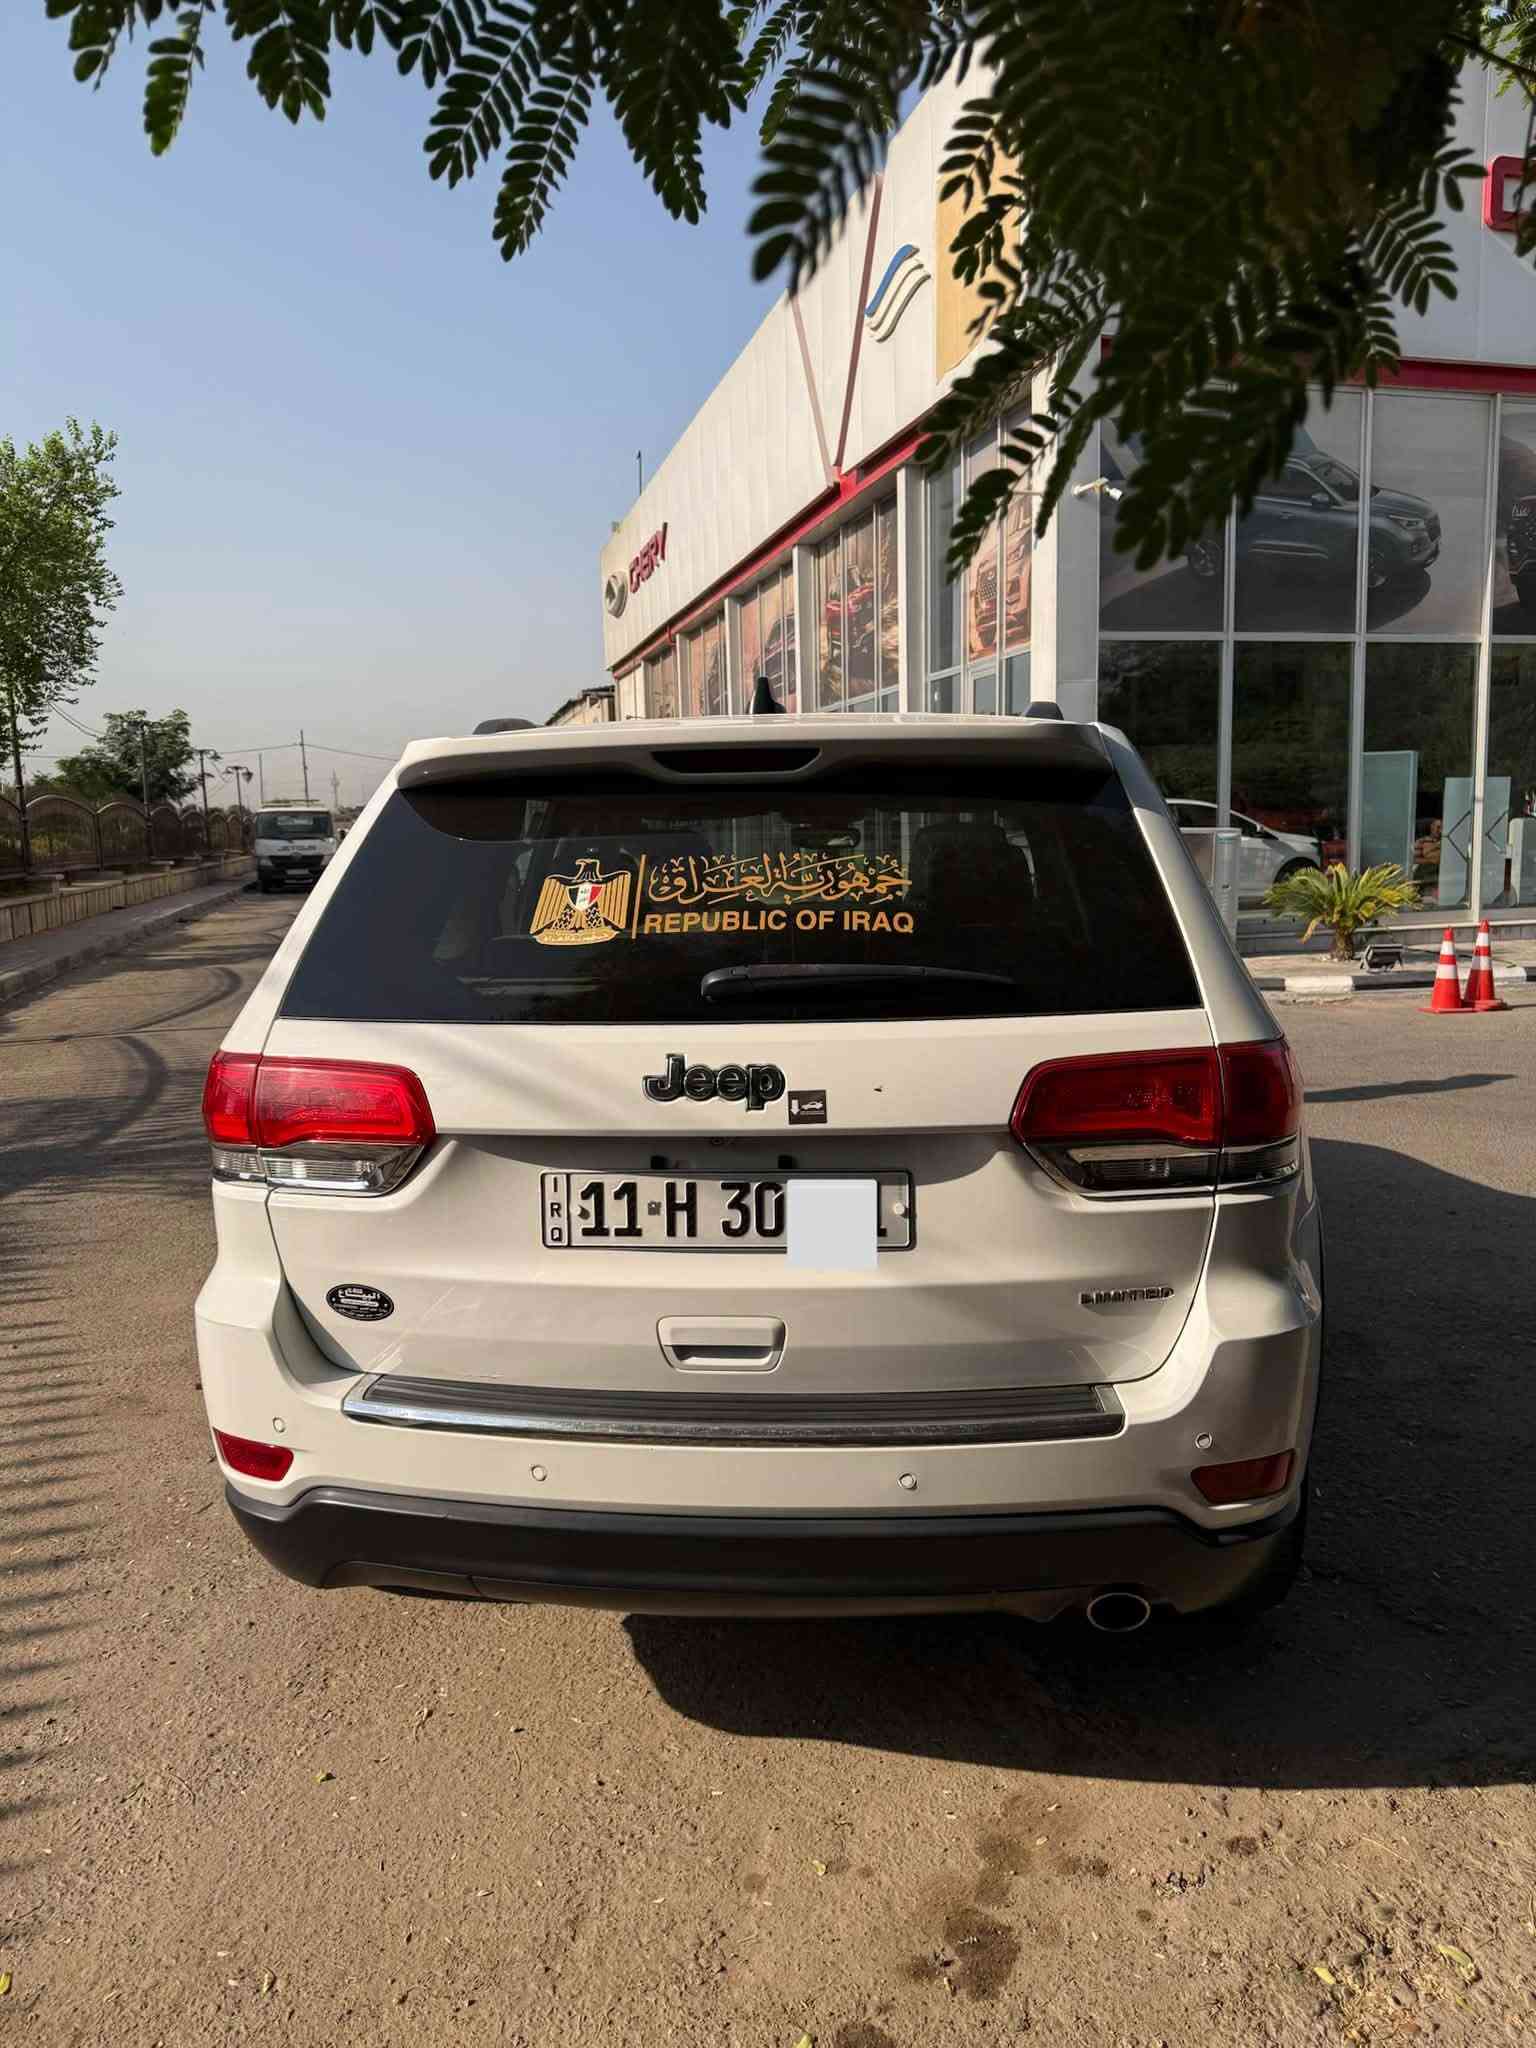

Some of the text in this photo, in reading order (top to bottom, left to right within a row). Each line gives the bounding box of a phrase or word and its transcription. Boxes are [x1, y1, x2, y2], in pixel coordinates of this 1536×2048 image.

[629, 522, 668, 594] CHERY
[643, 909, 914, 935] REPUBLIC OF IRAQ
[643, 1053, 787, 1112] Jeep
[580, 1181, 643, 1237] 11
[665, 1181, 697, 1237] H
